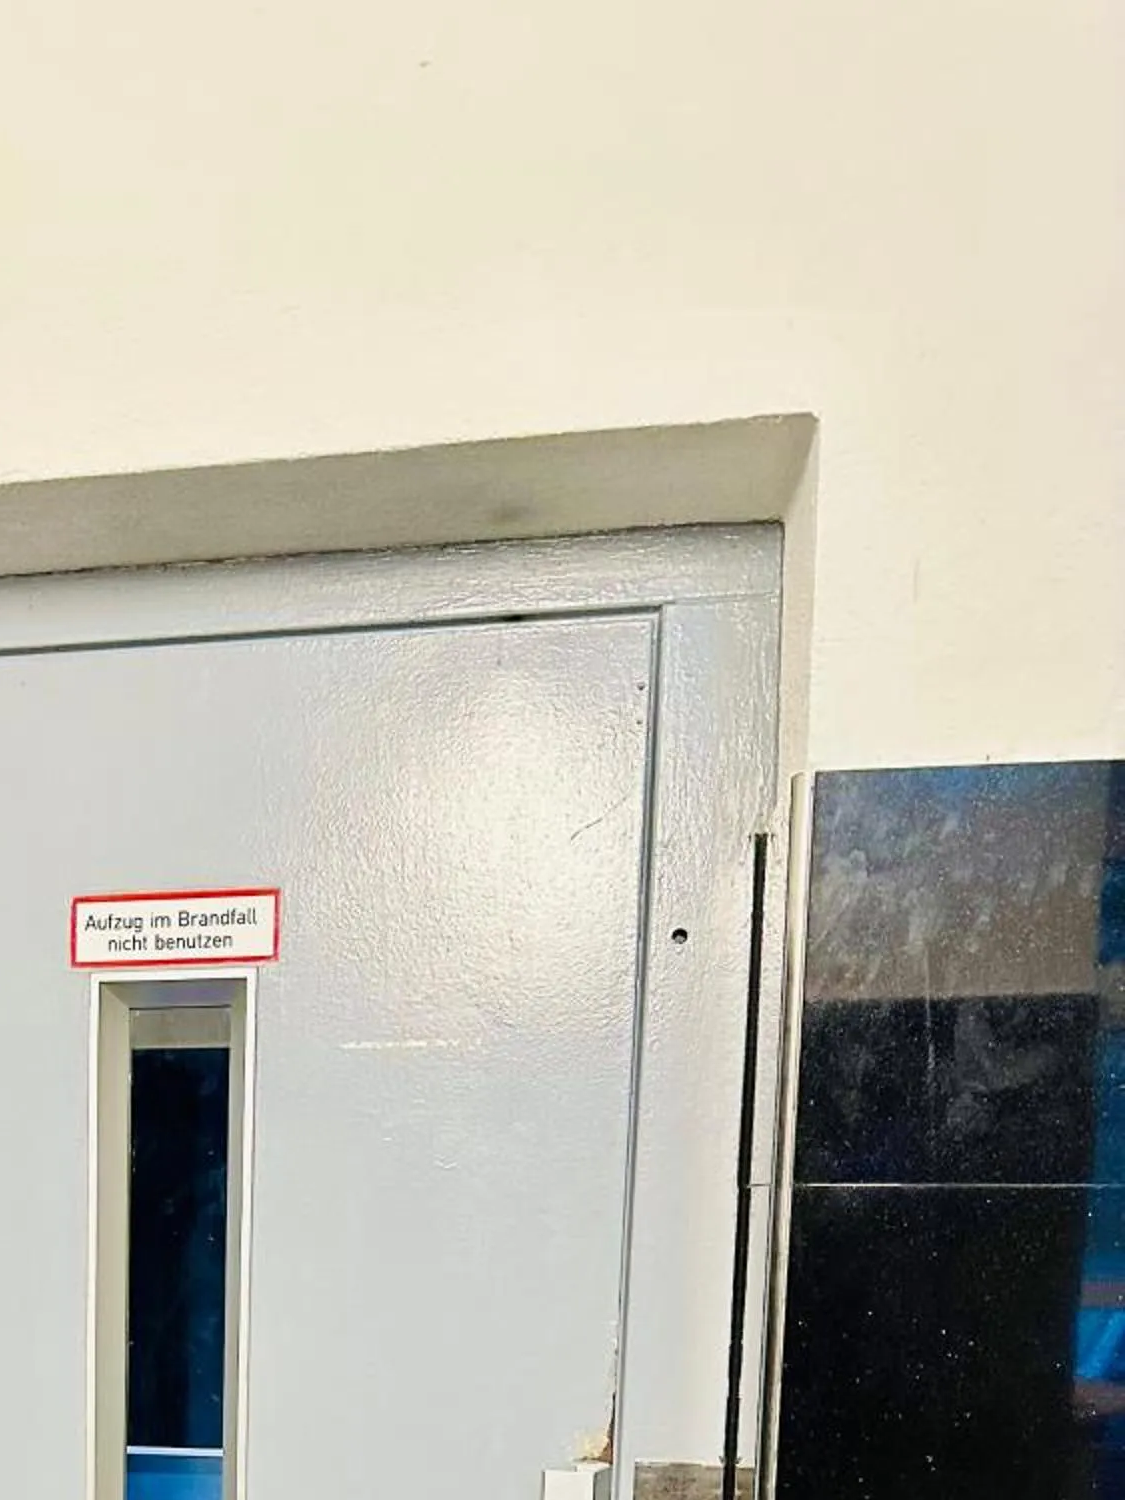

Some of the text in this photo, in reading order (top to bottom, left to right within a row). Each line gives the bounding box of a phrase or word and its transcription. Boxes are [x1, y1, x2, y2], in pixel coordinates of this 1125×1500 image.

[85, 909, 257, 932] Aufzug im Brandfall
[108, 934, 233, 951] nicht benutzen
